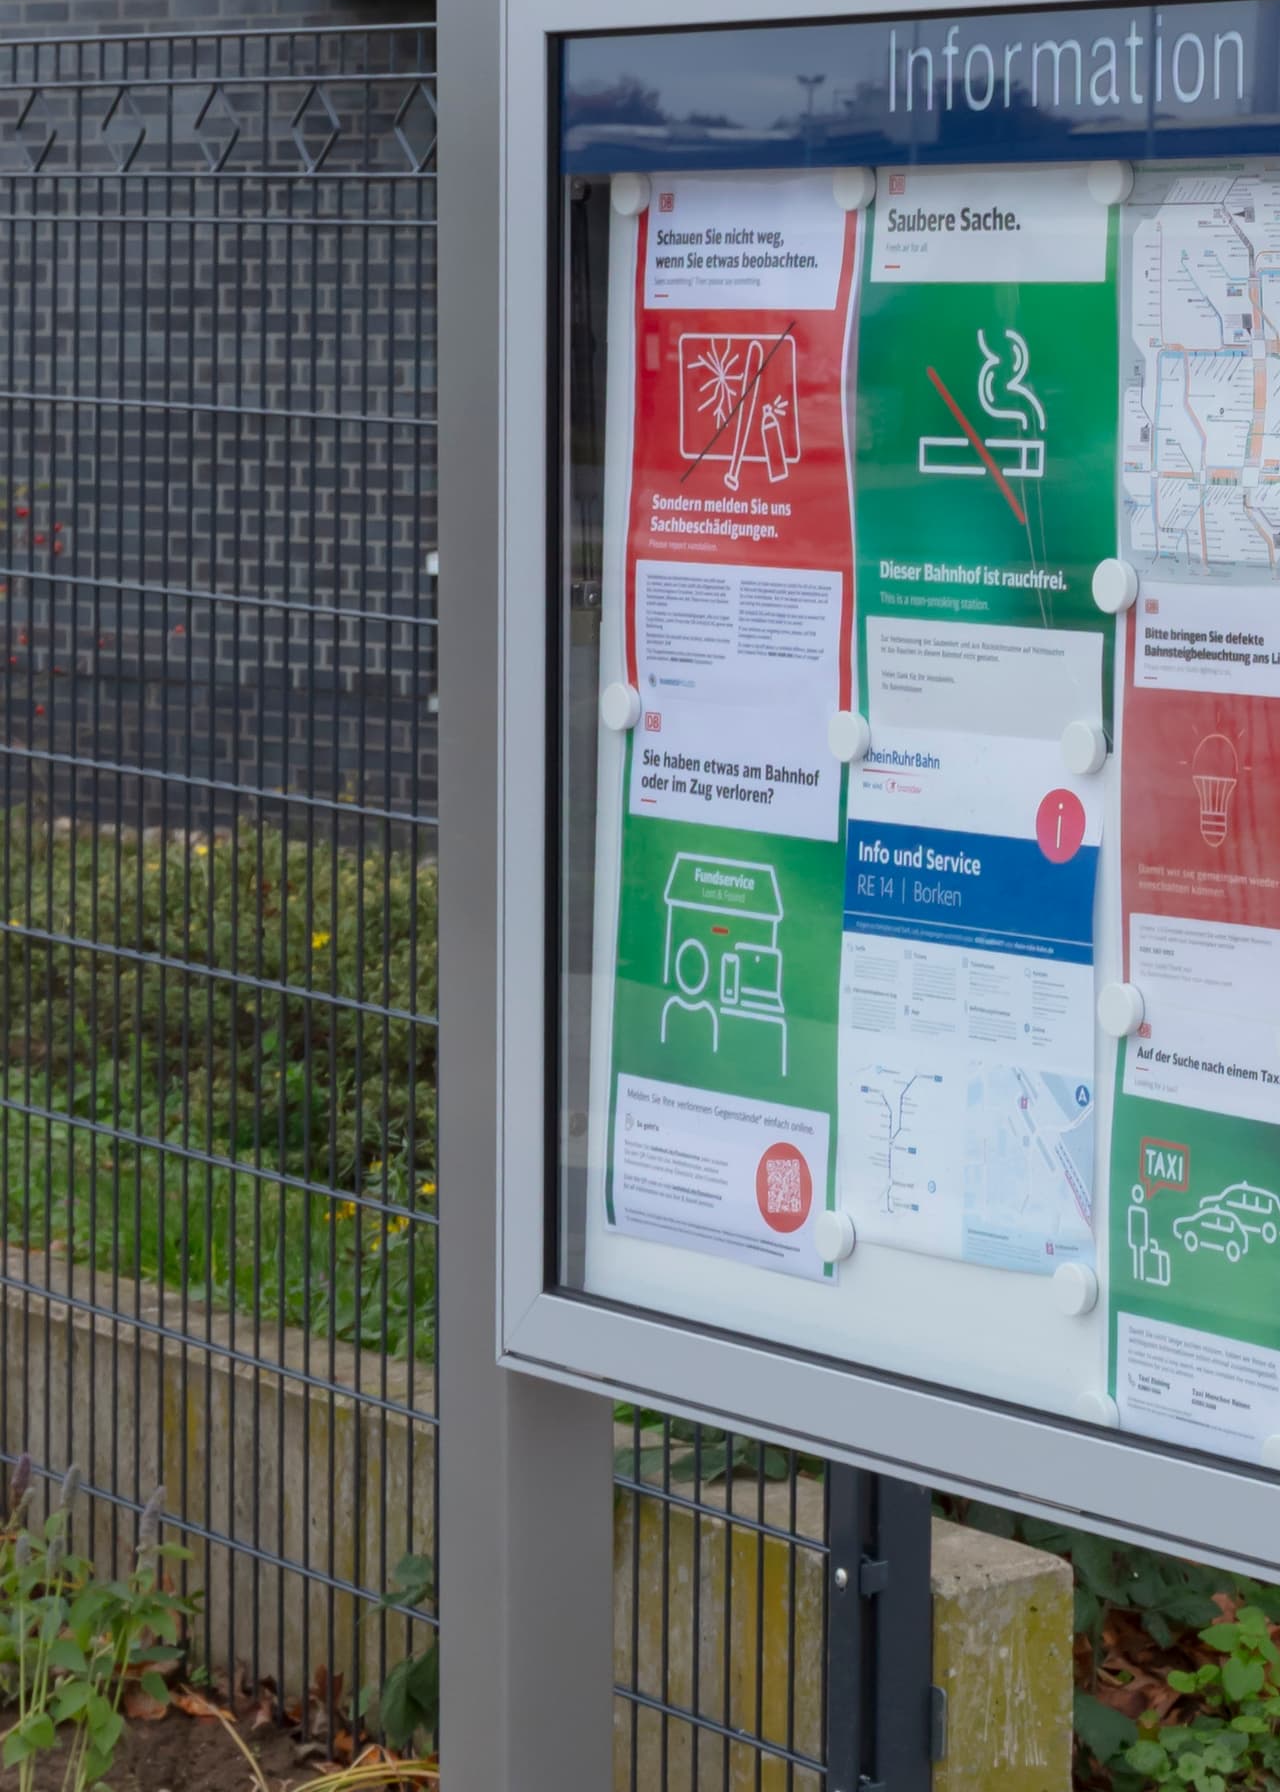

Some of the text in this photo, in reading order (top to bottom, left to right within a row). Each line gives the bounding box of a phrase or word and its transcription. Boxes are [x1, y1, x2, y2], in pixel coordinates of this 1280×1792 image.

[889, 13, 1244, 112] Information
[887, 206, 1021, 232] Saubere Sache.
[656, 228, 784, 248] Schauen Sie nicht weg,
[655, 252, 819, 269] wenn Sie etwas beobachten.
[652, 494, 791, 516] Sondern melden Sie uns
[650, 515, 778, 540] Sachbeschädigungen.
[880, 560, 1067, 591] Dieser Bahnhof ist rauchfrei.
[1145, 627, 1264, 646] Bitte bringen Sie defekte
[1144, 644, 1251, 666] Bahnsteigbeleuchtung
[1253, 652, 1269, 664] ans
[645, 712, 661, 733] DB
[643, 749, 820, 786] Sie haben etwas am Bahnhof
[641, 773, 774, 804] oder im Zug verloren?
[858, 840, 981, 875] Info und Service
[857, 873, 875, 897] RE
[879, 876, 893, 898] 14
[914, 880, 962, 907] Borken
[1137, 1046, 1153, 1060] Auf
[1155, 1050, 1171, 1064] der
[1172, 1053, 1200, 1070] Suche
[1201, 1060, 1224, 1075] nach
[1227, 1064, 1258, 1081] einem
[1146, 1148, 1184, 1182] TAXI
